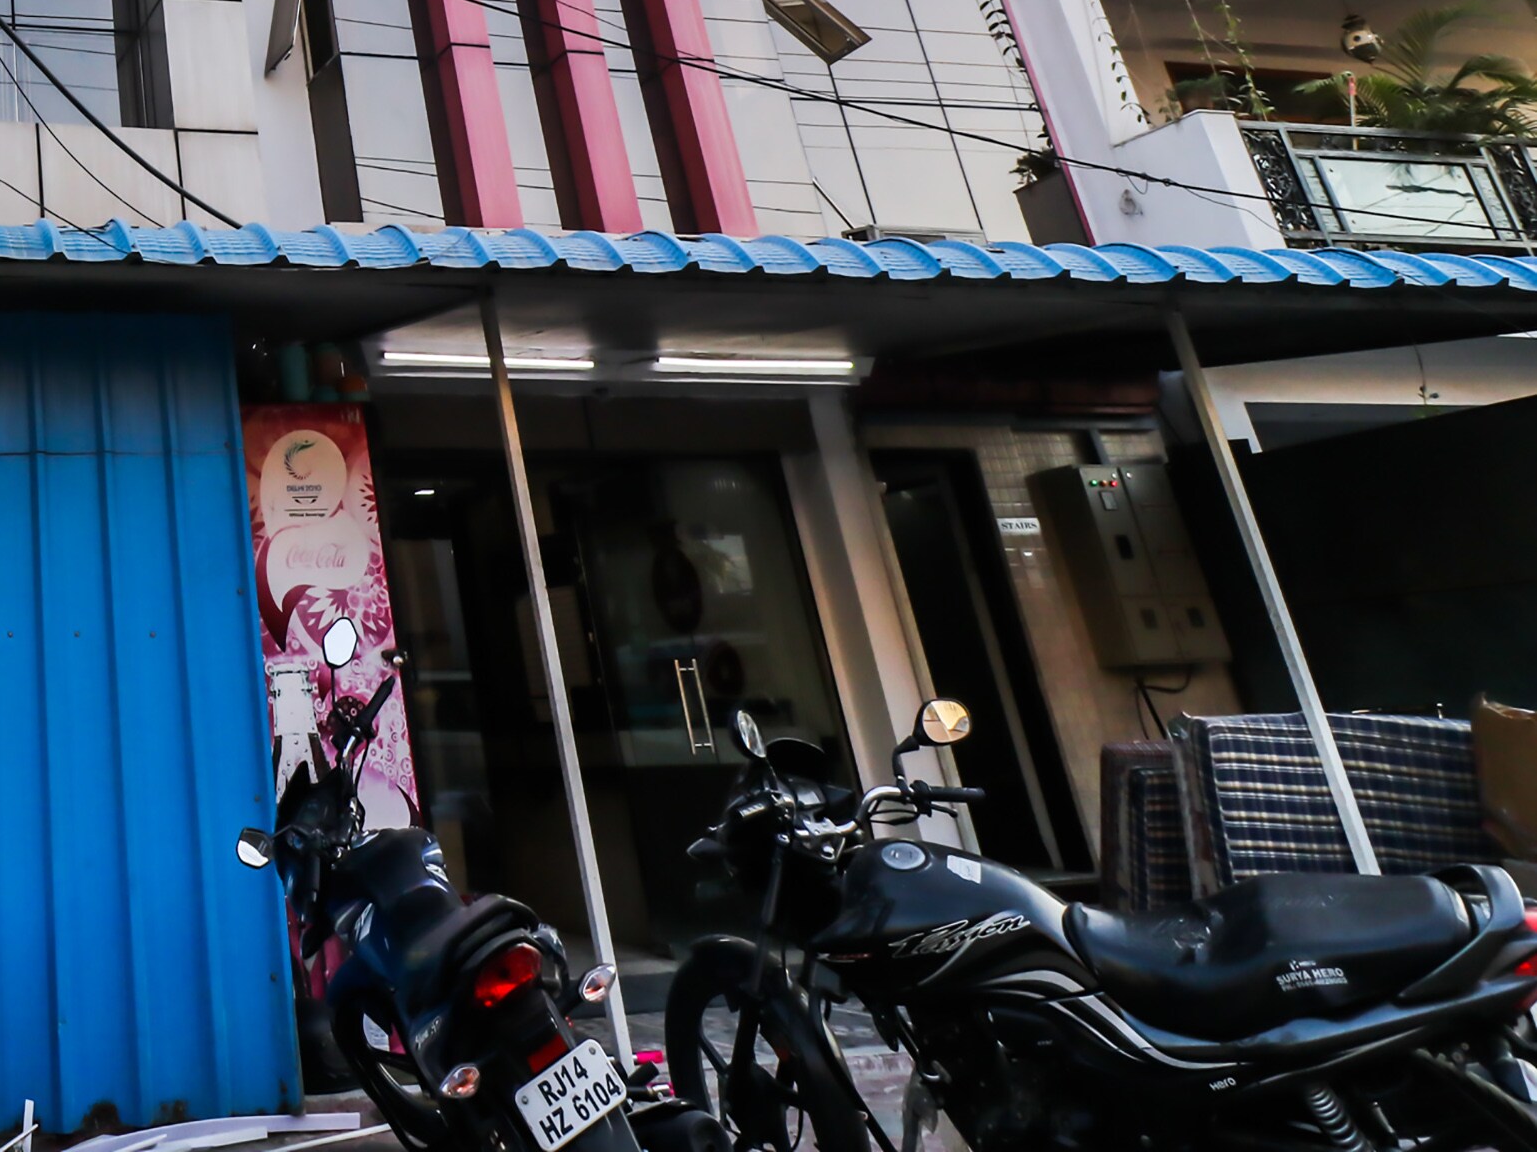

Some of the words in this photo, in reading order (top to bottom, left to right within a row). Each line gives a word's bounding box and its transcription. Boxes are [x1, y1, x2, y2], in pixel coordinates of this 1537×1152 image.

[1276, 969, 1311, 986] SURYA
[1311, 967, 1344, 979] HERO
[537, 1056, 589, 1107] RJ14
[1209, 1077, 1237, 1091] Hero
[539, 1107, 574, 1144] HZ
[572, 1073, 622, 1121] 6104
